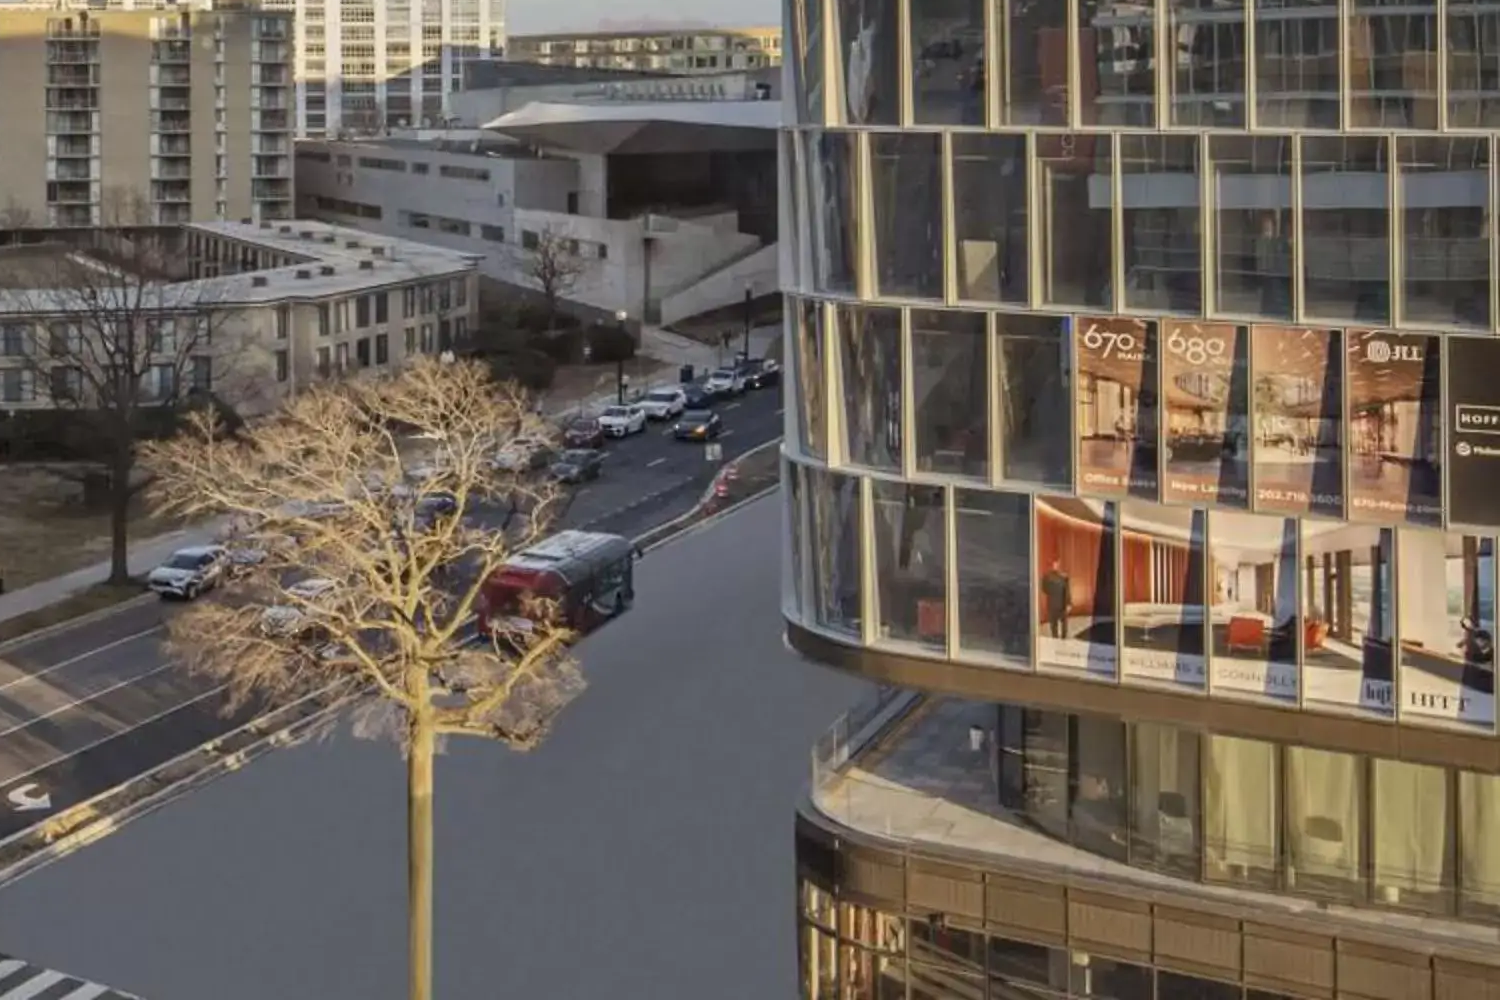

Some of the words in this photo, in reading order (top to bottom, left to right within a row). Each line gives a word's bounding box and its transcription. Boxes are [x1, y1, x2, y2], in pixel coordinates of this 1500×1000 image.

[1083, 323, 1135, 359] 670
[1167, 328, 1226, 365] 680
[1217, 668, 1299, 687] CONNOLLY
